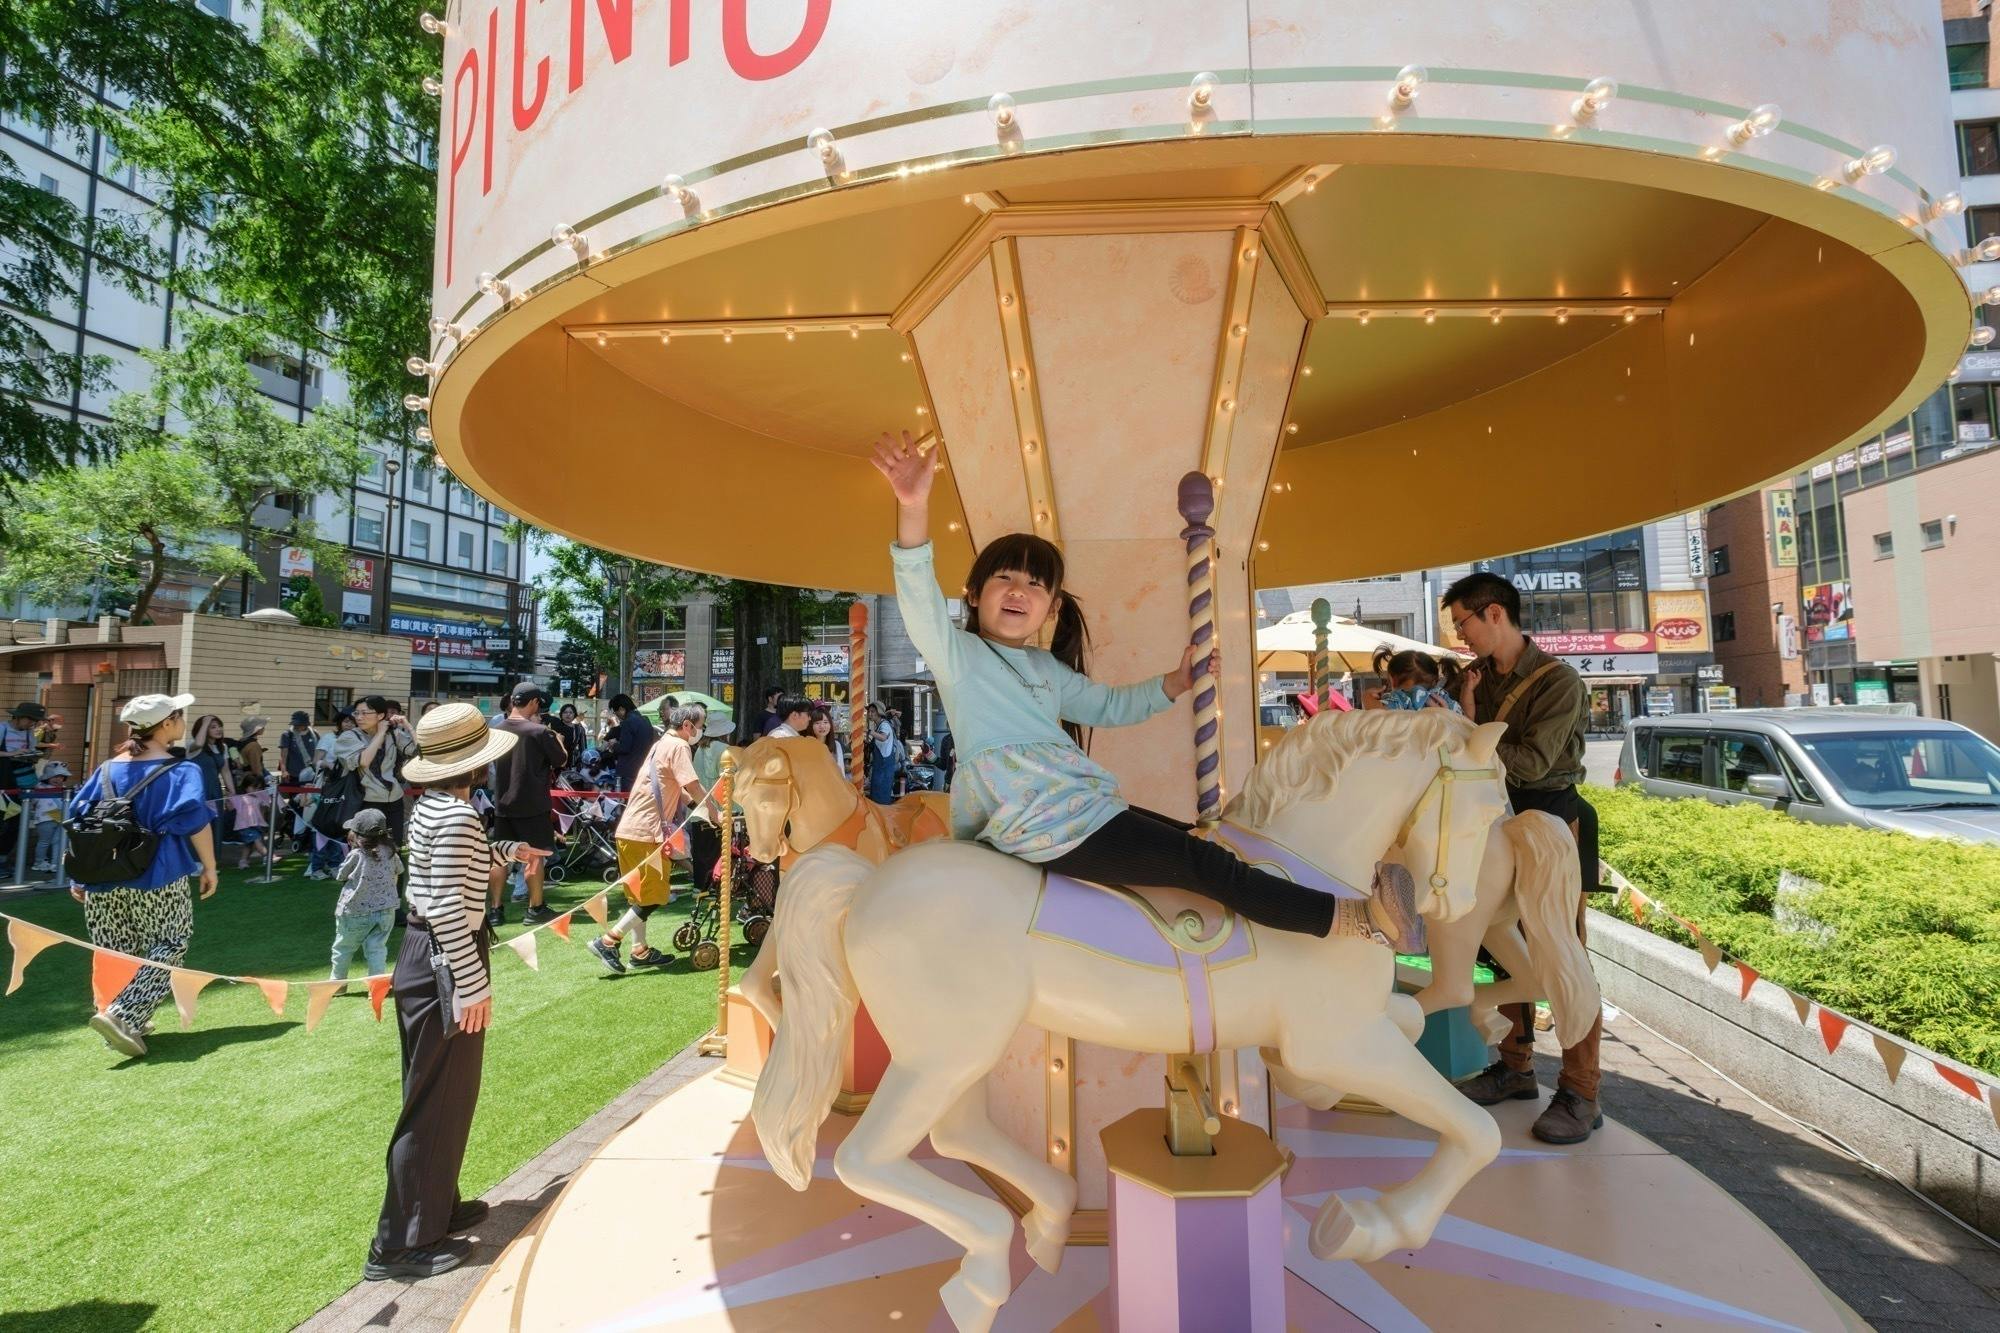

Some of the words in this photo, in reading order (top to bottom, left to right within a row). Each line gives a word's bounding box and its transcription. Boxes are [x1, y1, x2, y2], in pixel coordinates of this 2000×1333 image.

[1690, 535, 1702, 574] 富士そば
[1500, 571, 1582, 591] AVIER
[1698, 670, 1723, 678] BAR
